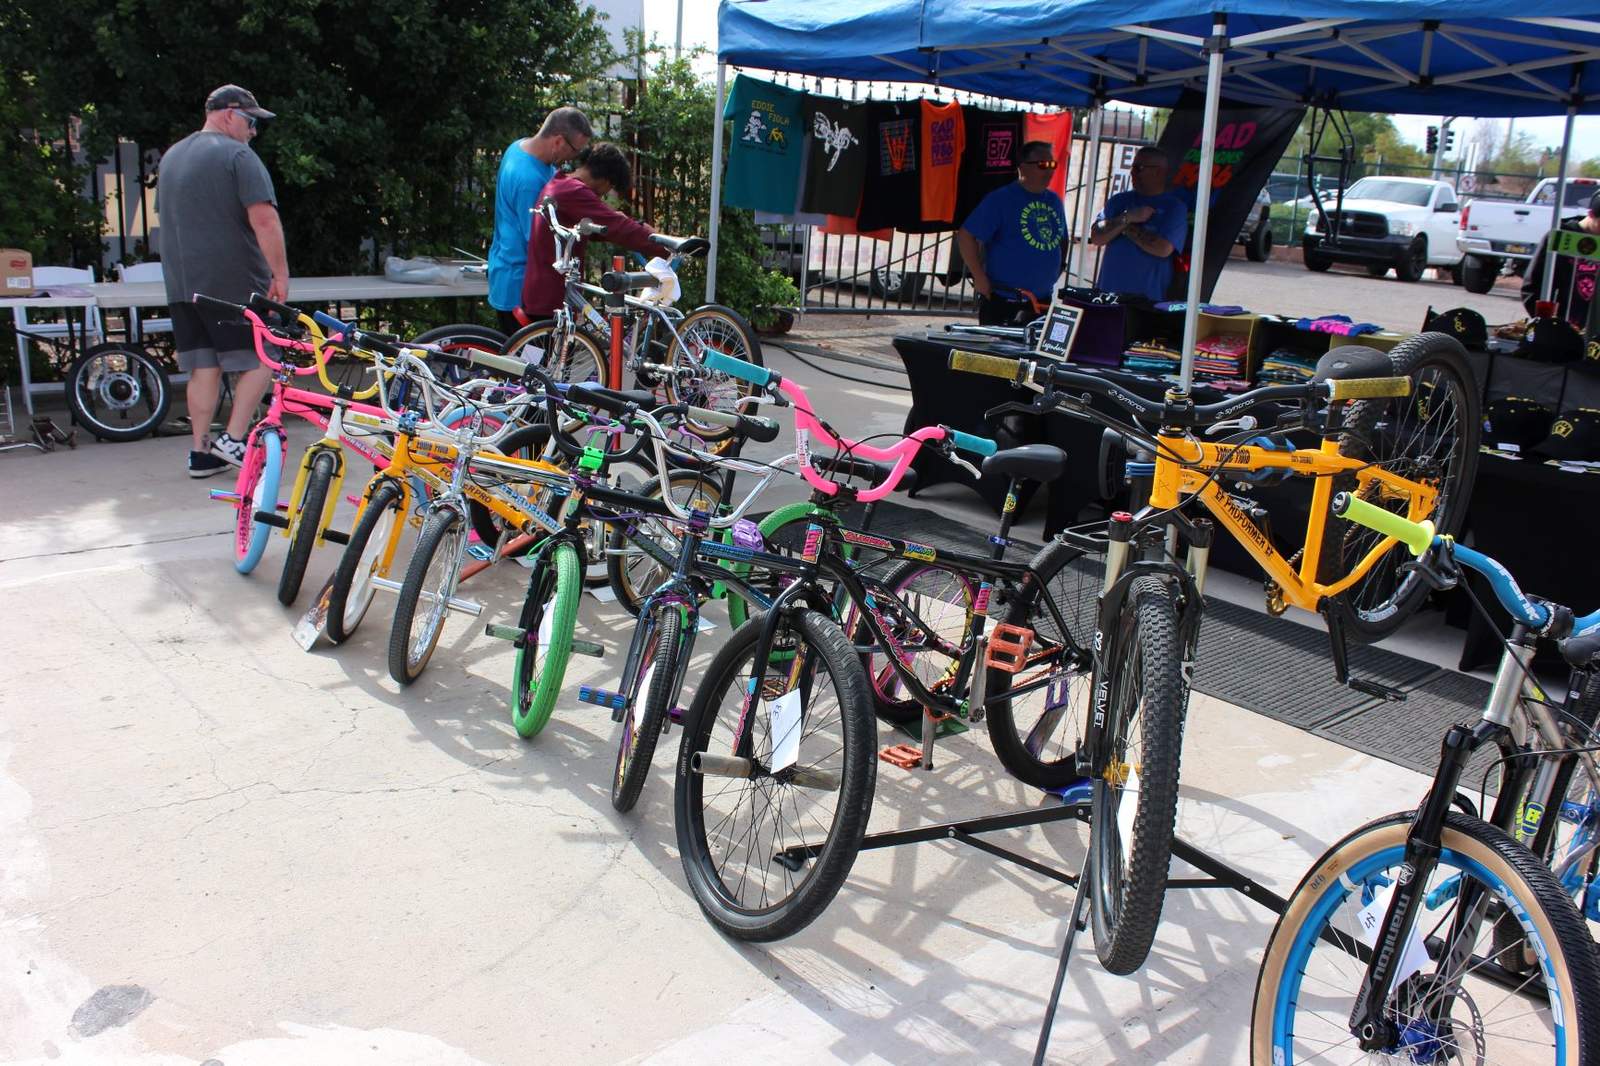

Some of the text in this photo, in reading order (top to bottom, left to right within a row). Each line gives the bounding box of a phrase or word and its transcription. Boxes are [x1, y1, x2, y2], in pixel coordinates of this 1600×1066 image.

[987, 137, 1013, 160] 87
[1093, 681, 1109, 729] VELVET
[1373, 893, 1410, 981] manitou
